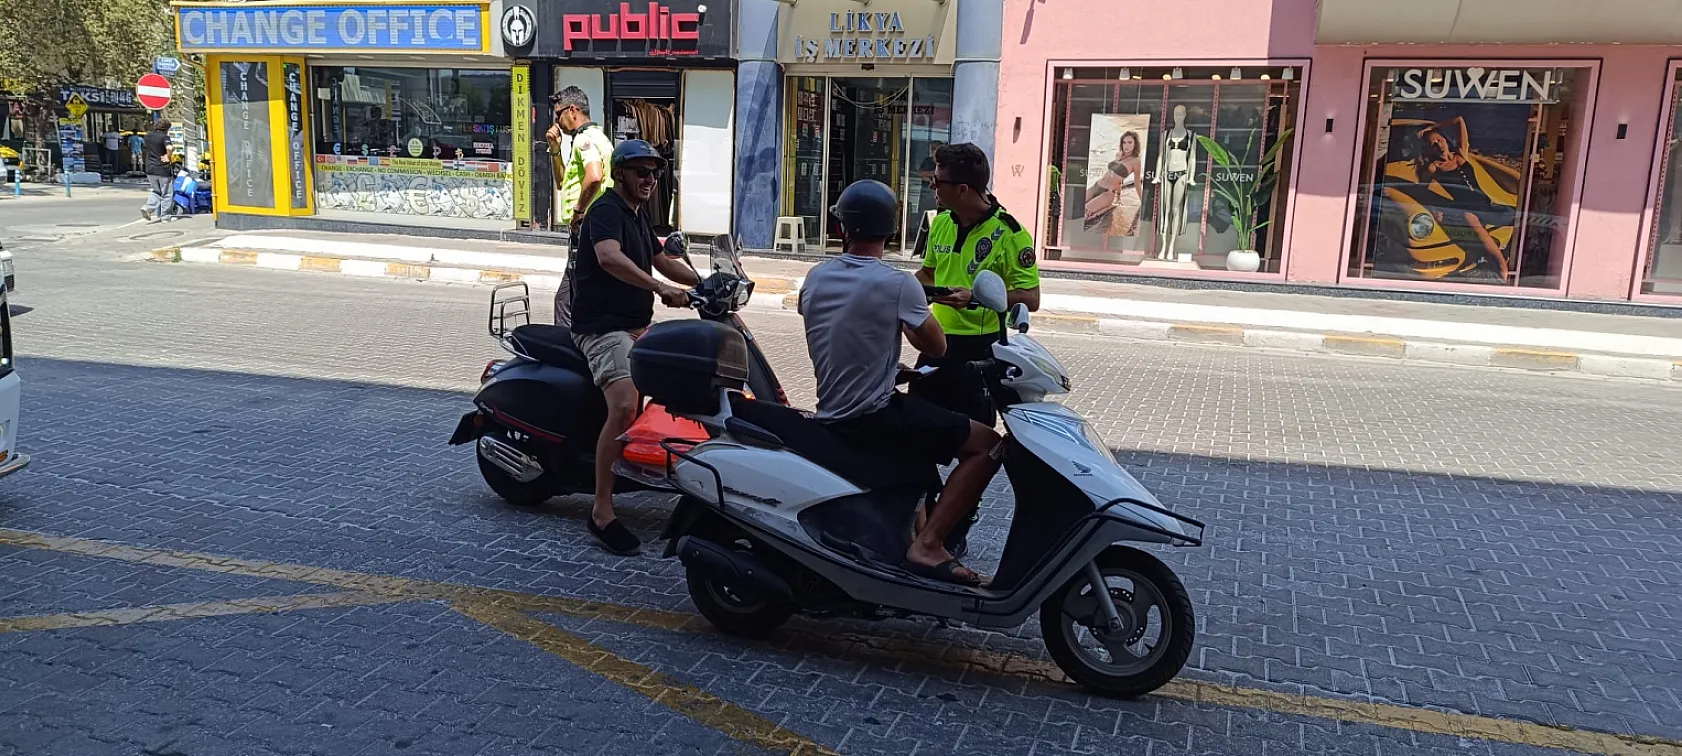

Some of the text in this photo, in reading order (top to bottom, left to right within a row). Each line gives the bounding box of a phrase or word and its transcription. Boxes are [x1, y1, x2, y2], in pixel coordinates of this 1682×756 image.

[181, 9, 327, 45] CHANGE
[338, 9, 477, 45] OFFICE
[563, 1, 699, 51] public
[829, 9, 905, 33] LİKYA
[795, 34, 936, 63] İŞ MERKEZİ
[1400, 67, 1551, 100] SUWEN
[516, 73, 526, 143] DİKMEN
[239, 72, 253, 197] CHANGE OFFICE
[289, 72, 302, 199] CHANGE OFFICE
[1215, 172, 1254, 183] SUWEN
